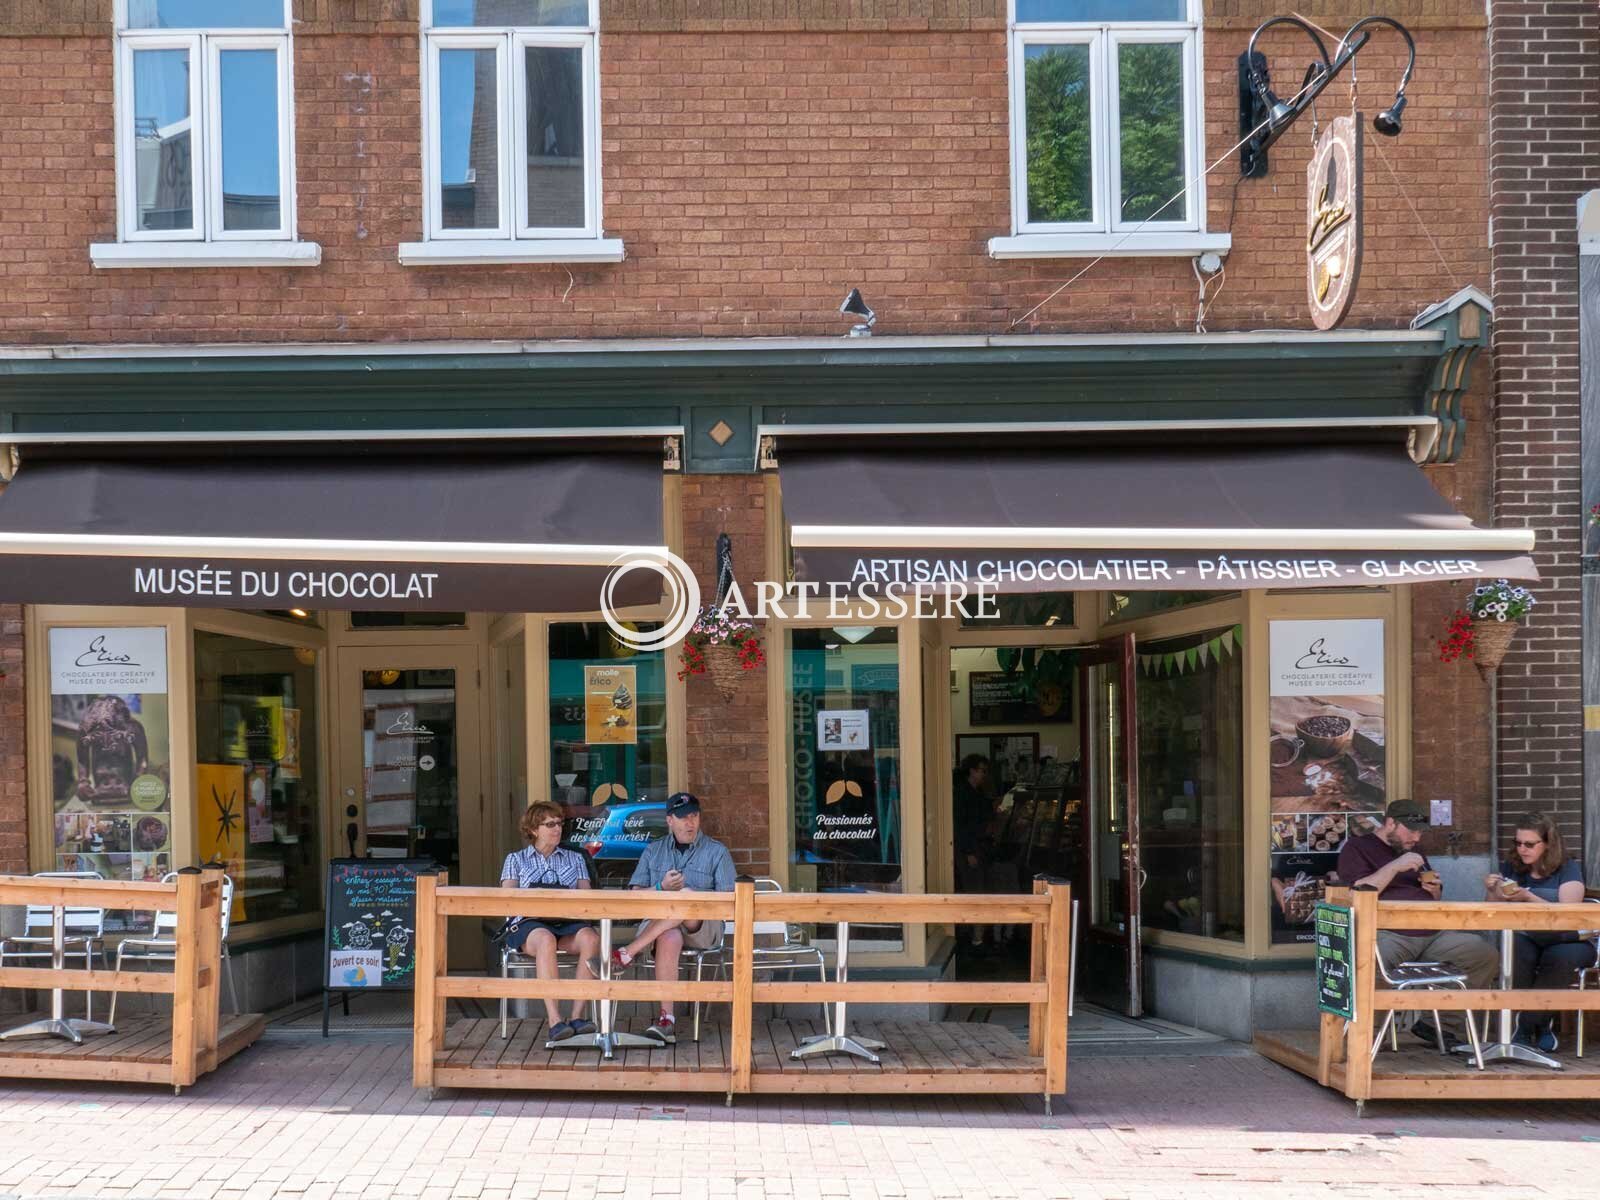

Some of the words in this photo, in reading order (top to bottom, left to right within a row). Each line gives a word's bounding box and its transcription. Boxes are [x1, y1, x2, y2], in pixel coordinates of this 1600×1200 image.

[851, 559, 968, 582] ARTISAN
[977, 559, 1171, 582] CHOCOLATIER
[1198, 556, 1341, 580] PÂTISSIER
[1362, 559, 1483, 578] GLACIER
[135, 564, 232, 596] MUSÉE
[241, 571, 279, 597] DU
[288, 571, 438, 598] CHOCOLAT
[815, 813, 873, 825] Passionnés
[570, 832, 587, 842] des
[813, 829, 828, 840] du
[829, 828, 877, 840] chocolat!
